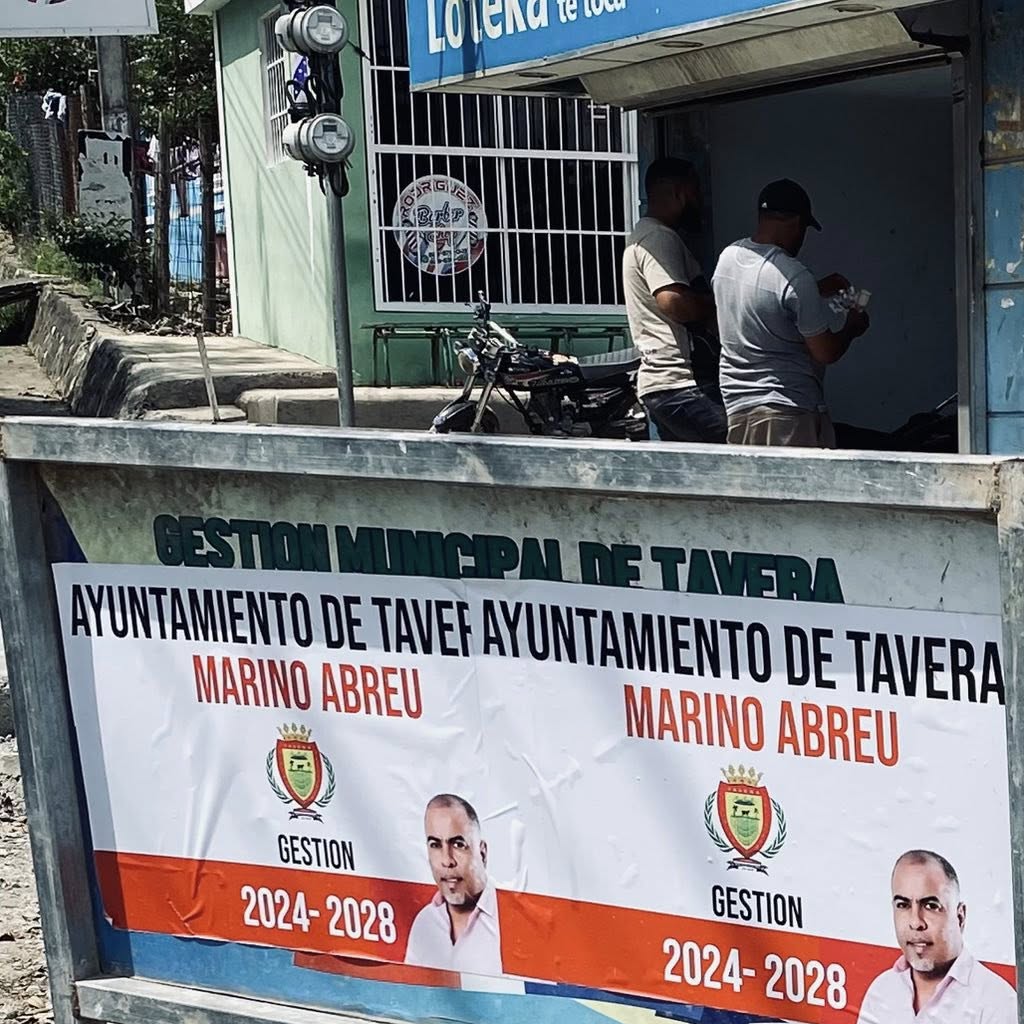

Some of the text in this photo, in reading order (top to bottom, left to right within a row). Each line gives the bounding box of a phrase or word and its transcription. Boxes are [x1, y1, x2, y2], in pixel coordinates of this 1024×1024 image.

[401, 180, 480, 217] RODRGUEZ
[153, 514, 845, 604] GESTION MUNICIPAL DE TAVERA
[71, 584, 312, 648] AYUNTAMIENTO
[323, 594, 366, 651] DE
[483, 599, 1006, 706] AYUNTAMIENTO DE TAVERA
[192, 654, 423, 720] MARINO ABREU
[623, 684, 900, 767] MARINO ABREU
[277, 834, 355, 872] GESTION
[711, 884, 803, 929] GESTION
